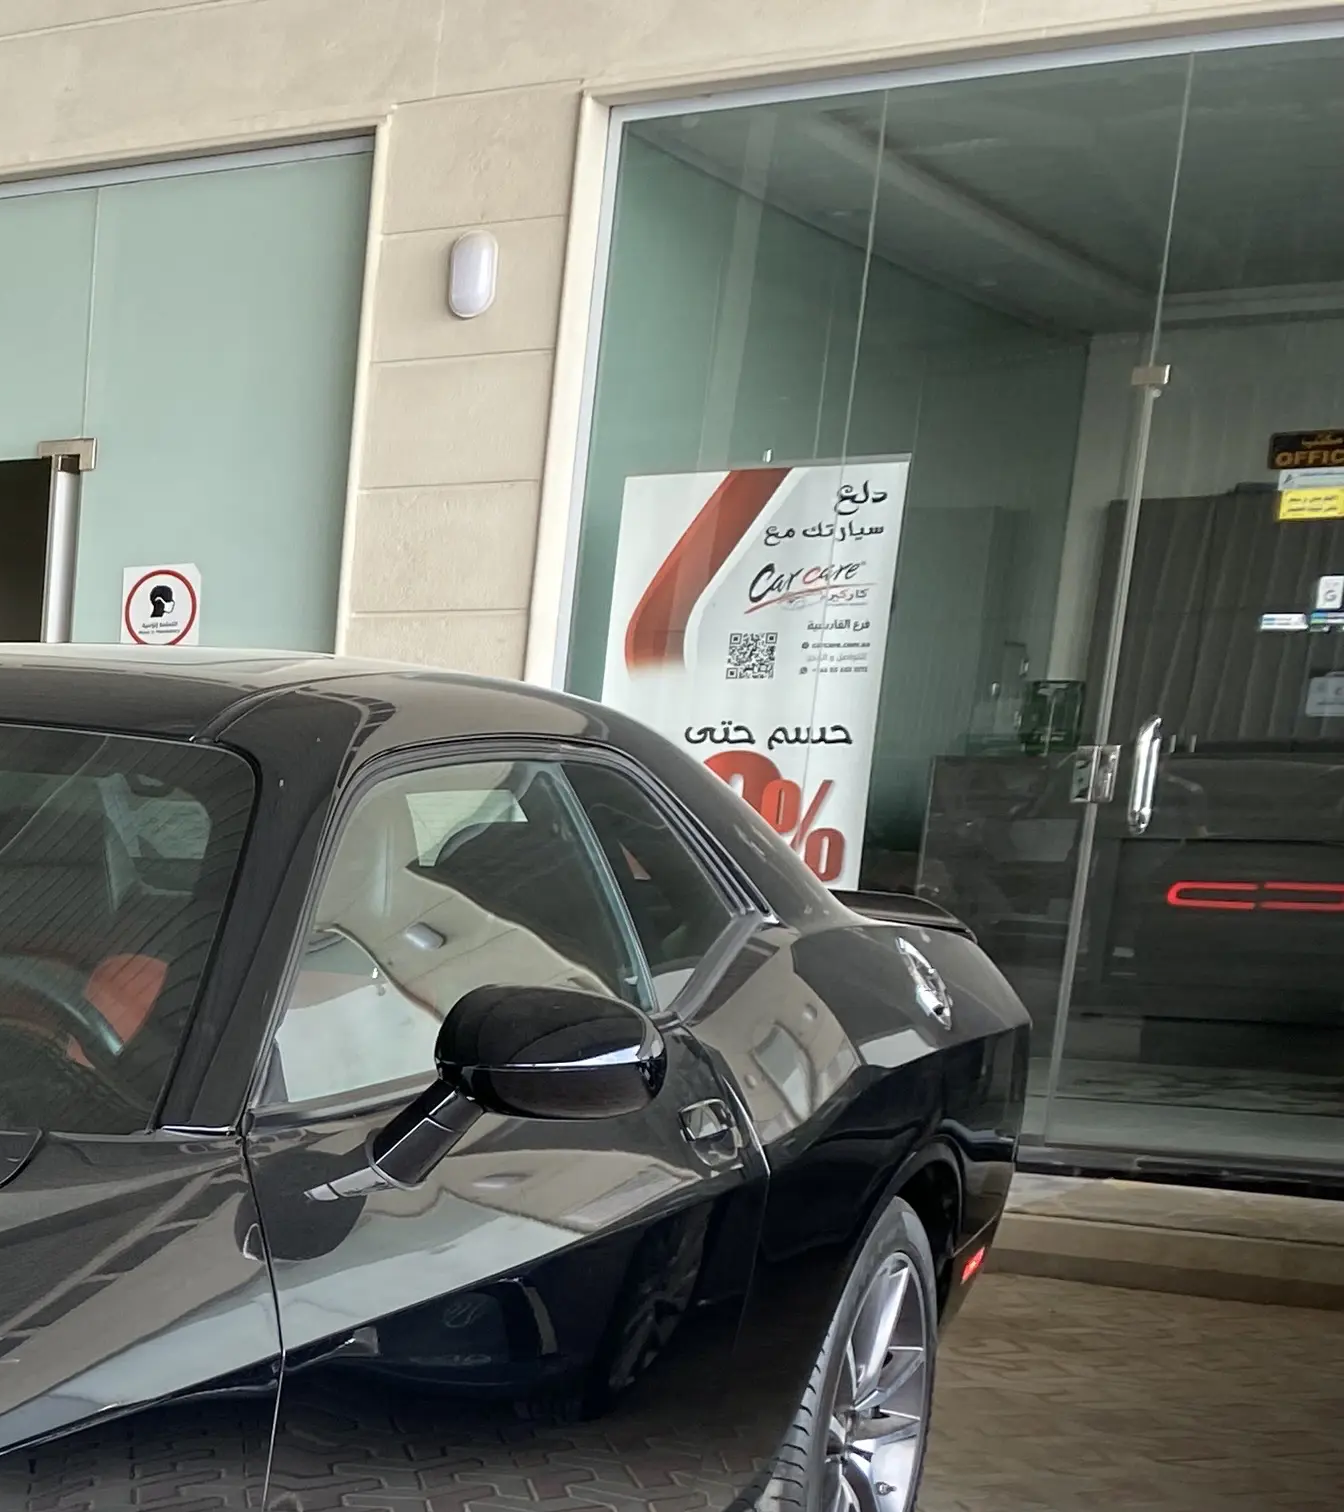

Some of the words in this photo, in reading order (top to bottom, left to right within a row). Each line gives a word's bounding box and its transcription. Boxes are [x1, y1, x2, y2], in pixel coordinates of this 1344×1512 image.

[834, 480, 888, 515] دلع
[763, 525, 795, 546] مع
[802, 520, 885, 541] سيارتك
[684, 720, 756, 745] حتى
[767, 723, 853, 750] حسم
